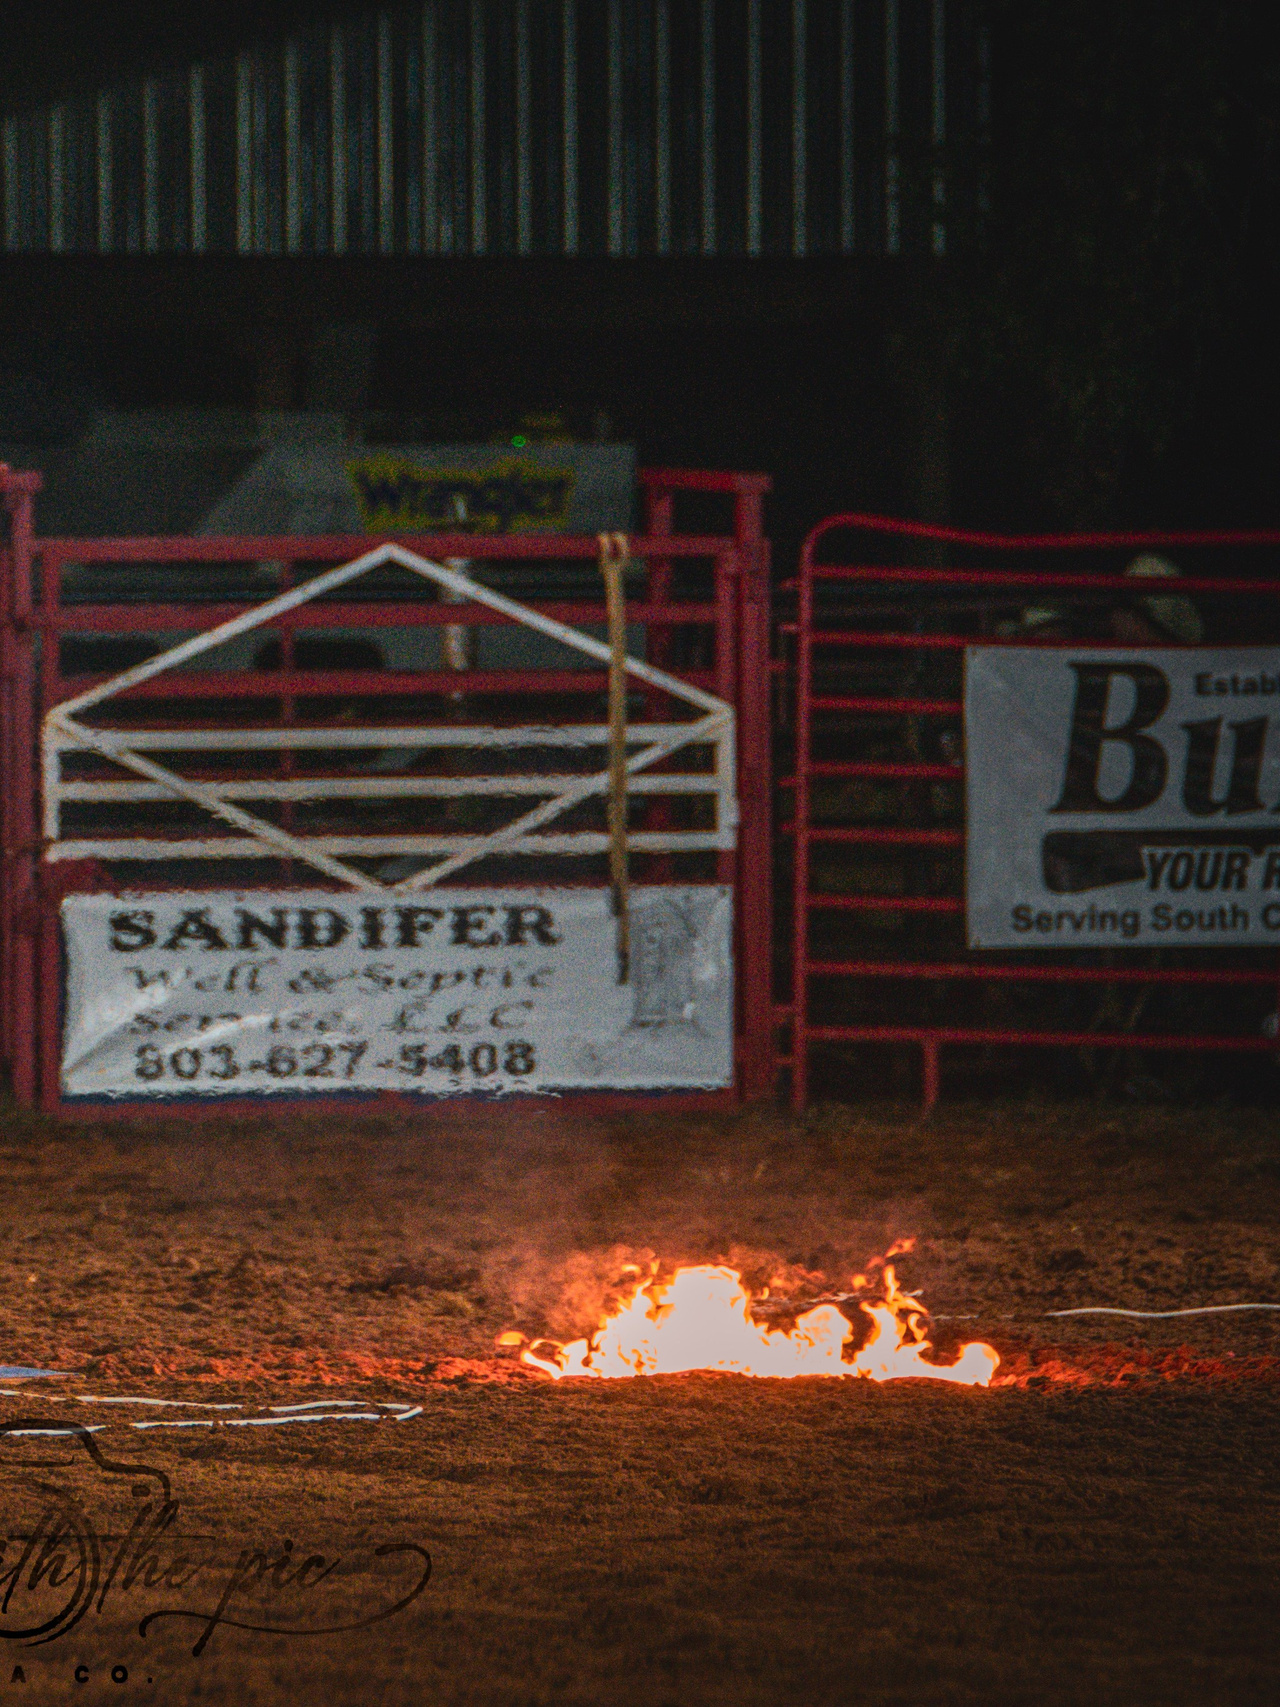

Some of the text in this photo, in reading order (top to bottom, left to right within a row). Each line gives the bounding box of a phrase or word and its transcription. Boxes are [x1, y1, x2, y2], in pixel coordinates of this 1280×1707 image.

[1195, 671, 1280, 696] Estab
[1047, 661, 1280, 818] Bu
[1148, 851, 1251, 891] YOUR
[110, 906, 563, 951] SANDIFER
[1011, 903, 1141, 938] Serving
[1151, 902, 1250, 931] South
[123, 956, 278, 993] Well
[358, 960, 555, 1002] Septic
[382, 1000, 536, 1034] LLC
[134, 1039, 536, 1081] 803-627-5408
